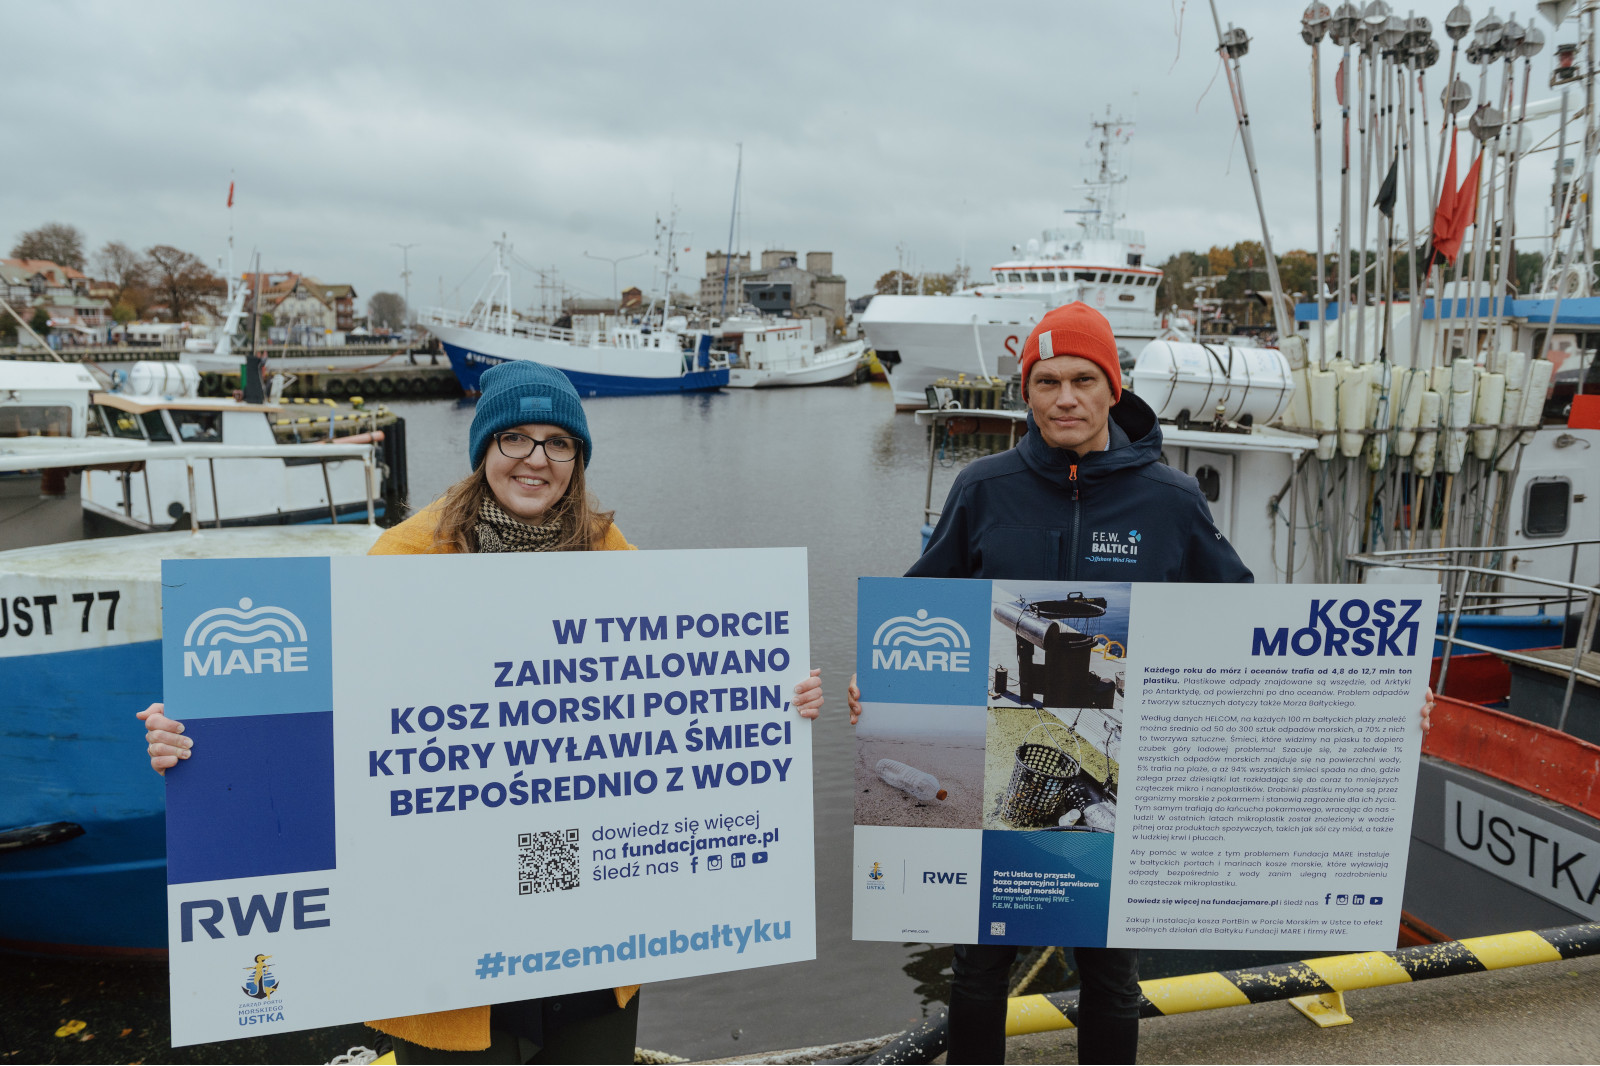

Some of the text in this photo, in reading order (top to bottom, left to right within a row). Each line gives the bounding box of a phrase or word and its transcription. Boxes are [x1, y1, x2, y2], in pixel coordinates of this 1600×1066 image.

[1092, 532, 1119, 542] F.E.W.
[1092, 543, 1137, 555] BALTIC II
[72, 590, 120, 632] 77
[1309, 599, 1422, 629] KOSZ
[553, 611, 789, 644] W TYM PORCIE
[1252, 622, 1419, 656] MORSKI
[184, 647, 308, 676] MARE
[494, 648, 790, 687] ZAINSTALOWANO
[872, 649, 970, 672] MARE
[1144, 666, 1180, 675] Każdego
[1183, 666, 1203, 674] roku
[1220, 666, 1242, 674] mórz
[1244, 666, 1248, 674] i
[1250, 666, 1288, 674] oceanów
[1291, 666, 1314, 674] trafia
[1331, 667, 1345, 675] 4,8
[1362, 667, 1376, 675] 12,7
[1143, 676, 1180, 685] plastiku.
[1229, 677, 1261, 686] odpady
[1329, 678, 1366, 686] wszędzie,
[1384, 678, 1411, 686] Arktyki
[1147, 698, 1180, 707] tworzyw
[1227, 699, 1258, 708] dotyczy
[1282, 699, 1307, 707] Morza
[1296, 688, 1335, 696] oceanów.
[1372, 688, 1410, 698] odpadów
[391, 685, 790, 734] KOSZ MORSKI PORTBIN,
[369, 719, 791, 777] KTÓRY WYŁAWIA ŚMIECI
[390, 758, 793, 816] BEZPOŚREDNIO Z WODY
[592, 810, 760, 841] dowiedz się więcej
[593, 828, 779, 861] na fundacjamare.pl
[593, 861, 679, 881] śledź nas
[923, 872, 967, 884] RWE
[1044, 872, 1075, 880] przyszła
[1013, 879, 1055, 887] operacyjna
[1033, 887, 1065, 895] morskiej
[993, 894, 1014, 902] farmy
[1015, 895, 1052, 903] wiatrowej
[1127, 896, 1160, 904] Dowiedz
[1161, 897, 1173, 905] się
[1174, 897, 1200, 906] więcej
[1283, 897, 1303, 906] śledź
[181, 888, 330, 942] RWE
[475, 919, 791, 979] #razemdlabałtyku
[239, 1005, 283, 1015] MORSKIEGO
[239, 1012, 284, 1026] USTKA
